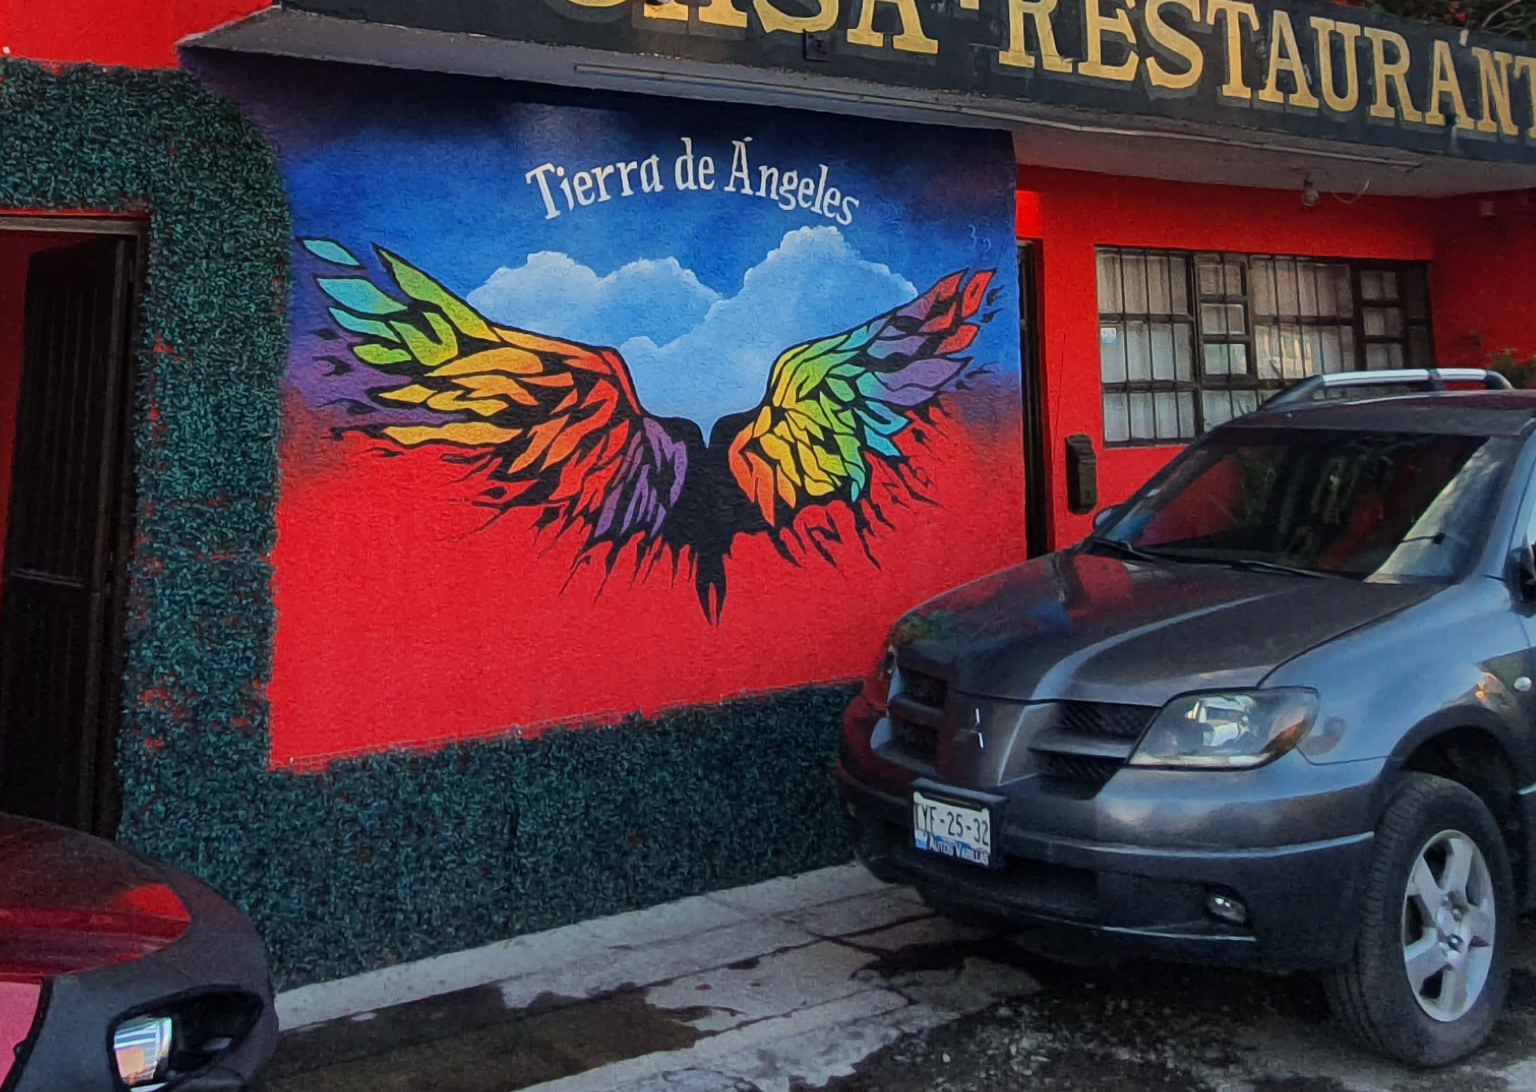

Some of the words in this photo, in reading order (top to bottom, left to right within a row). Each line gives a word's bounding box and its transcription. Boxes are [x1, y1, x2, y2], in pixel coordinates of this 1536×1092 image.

[525, 154, 665, 220] Tierra
[675, 137, 716, 191] de
[723, 136, 860, 226] Ángeles
